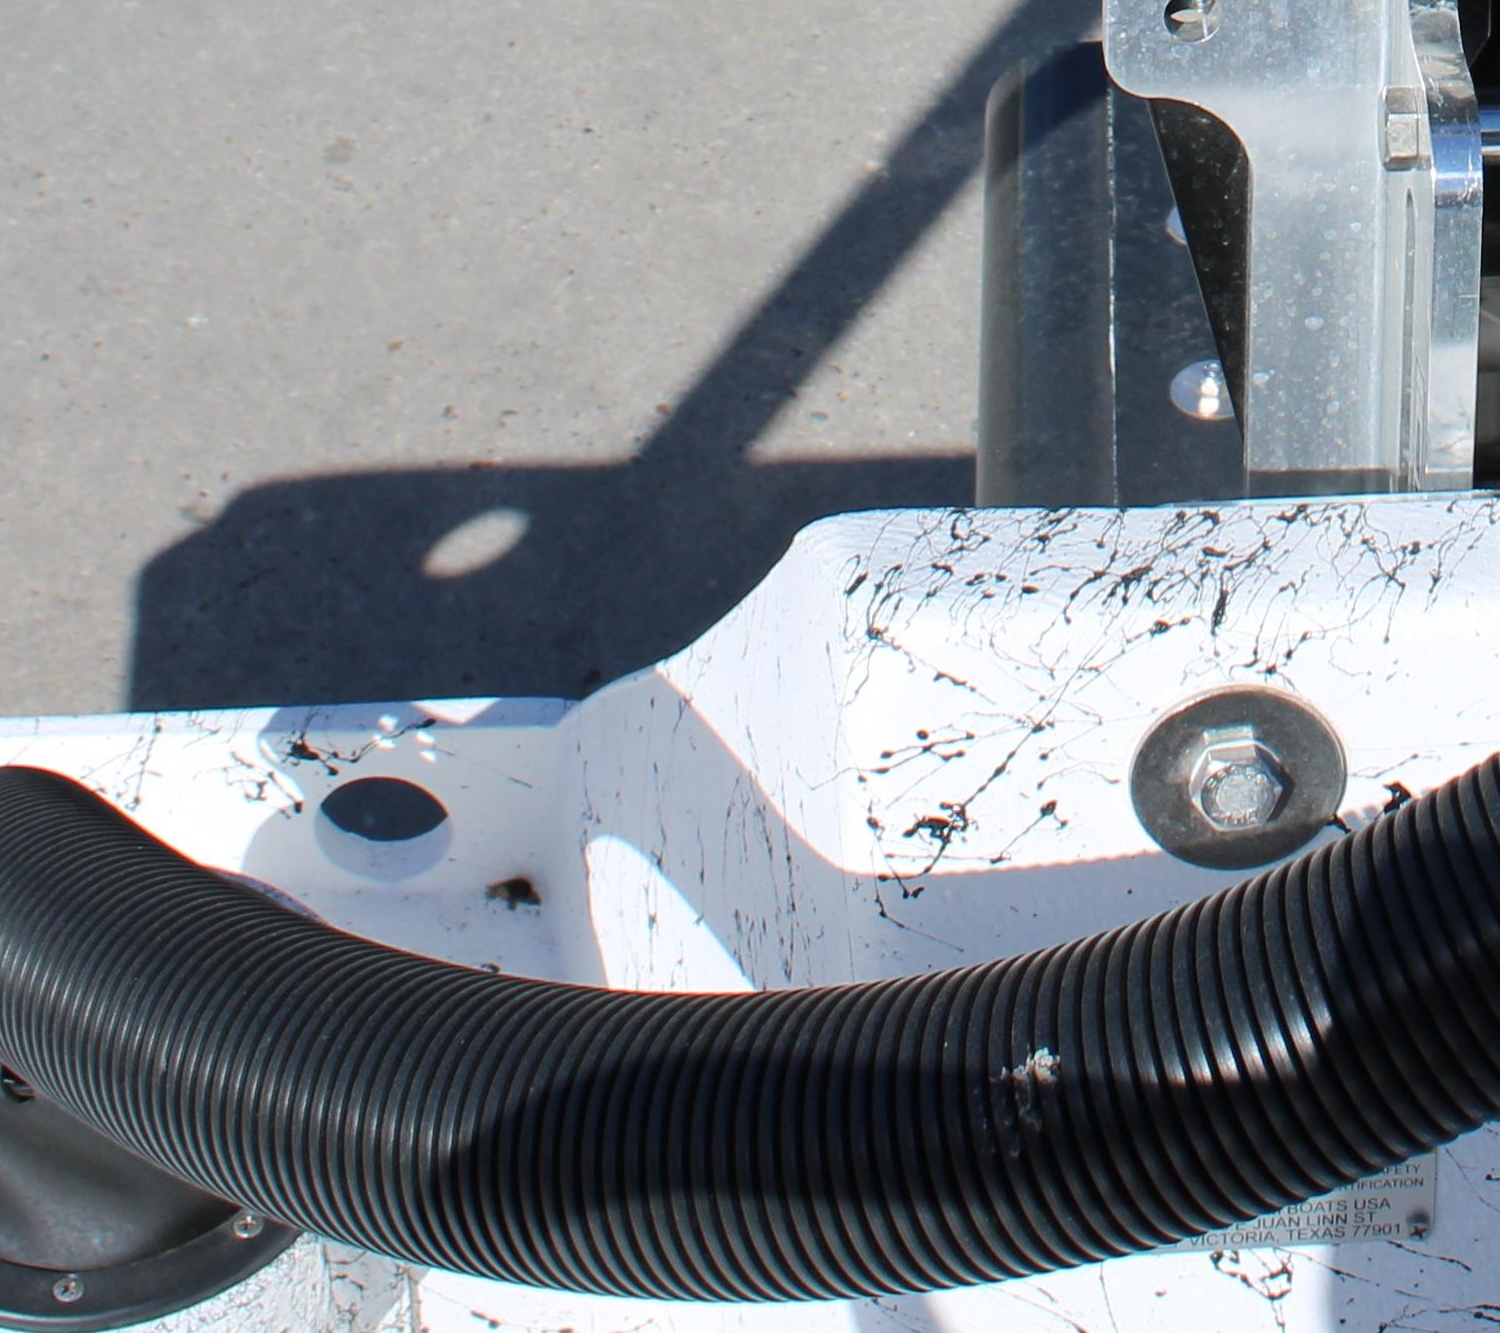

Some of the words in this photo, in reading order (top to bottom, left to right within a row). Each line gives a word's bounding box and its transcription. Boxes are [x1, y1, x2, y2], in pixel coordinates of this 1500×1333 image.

[1385, 1164, 1421, 1174] FETY
[1340, 1177, 1424, 1190] TIFICATION
[1288, 1199, 1347, 1214] BOATS
[1354, 1198, 1391, 1210] USA
[1253, 1217, 1300, 1230] JUAN
[1307, 1213, 1348, 1226] LINN
[1354, 1211, 1377, 1223] ST
[1190, 1231, 1279, 1246] VICTORIA,
[1288, 1226, 1346, 1241] TEXAS
[1352, 1224, 1401, 1237] 77901
